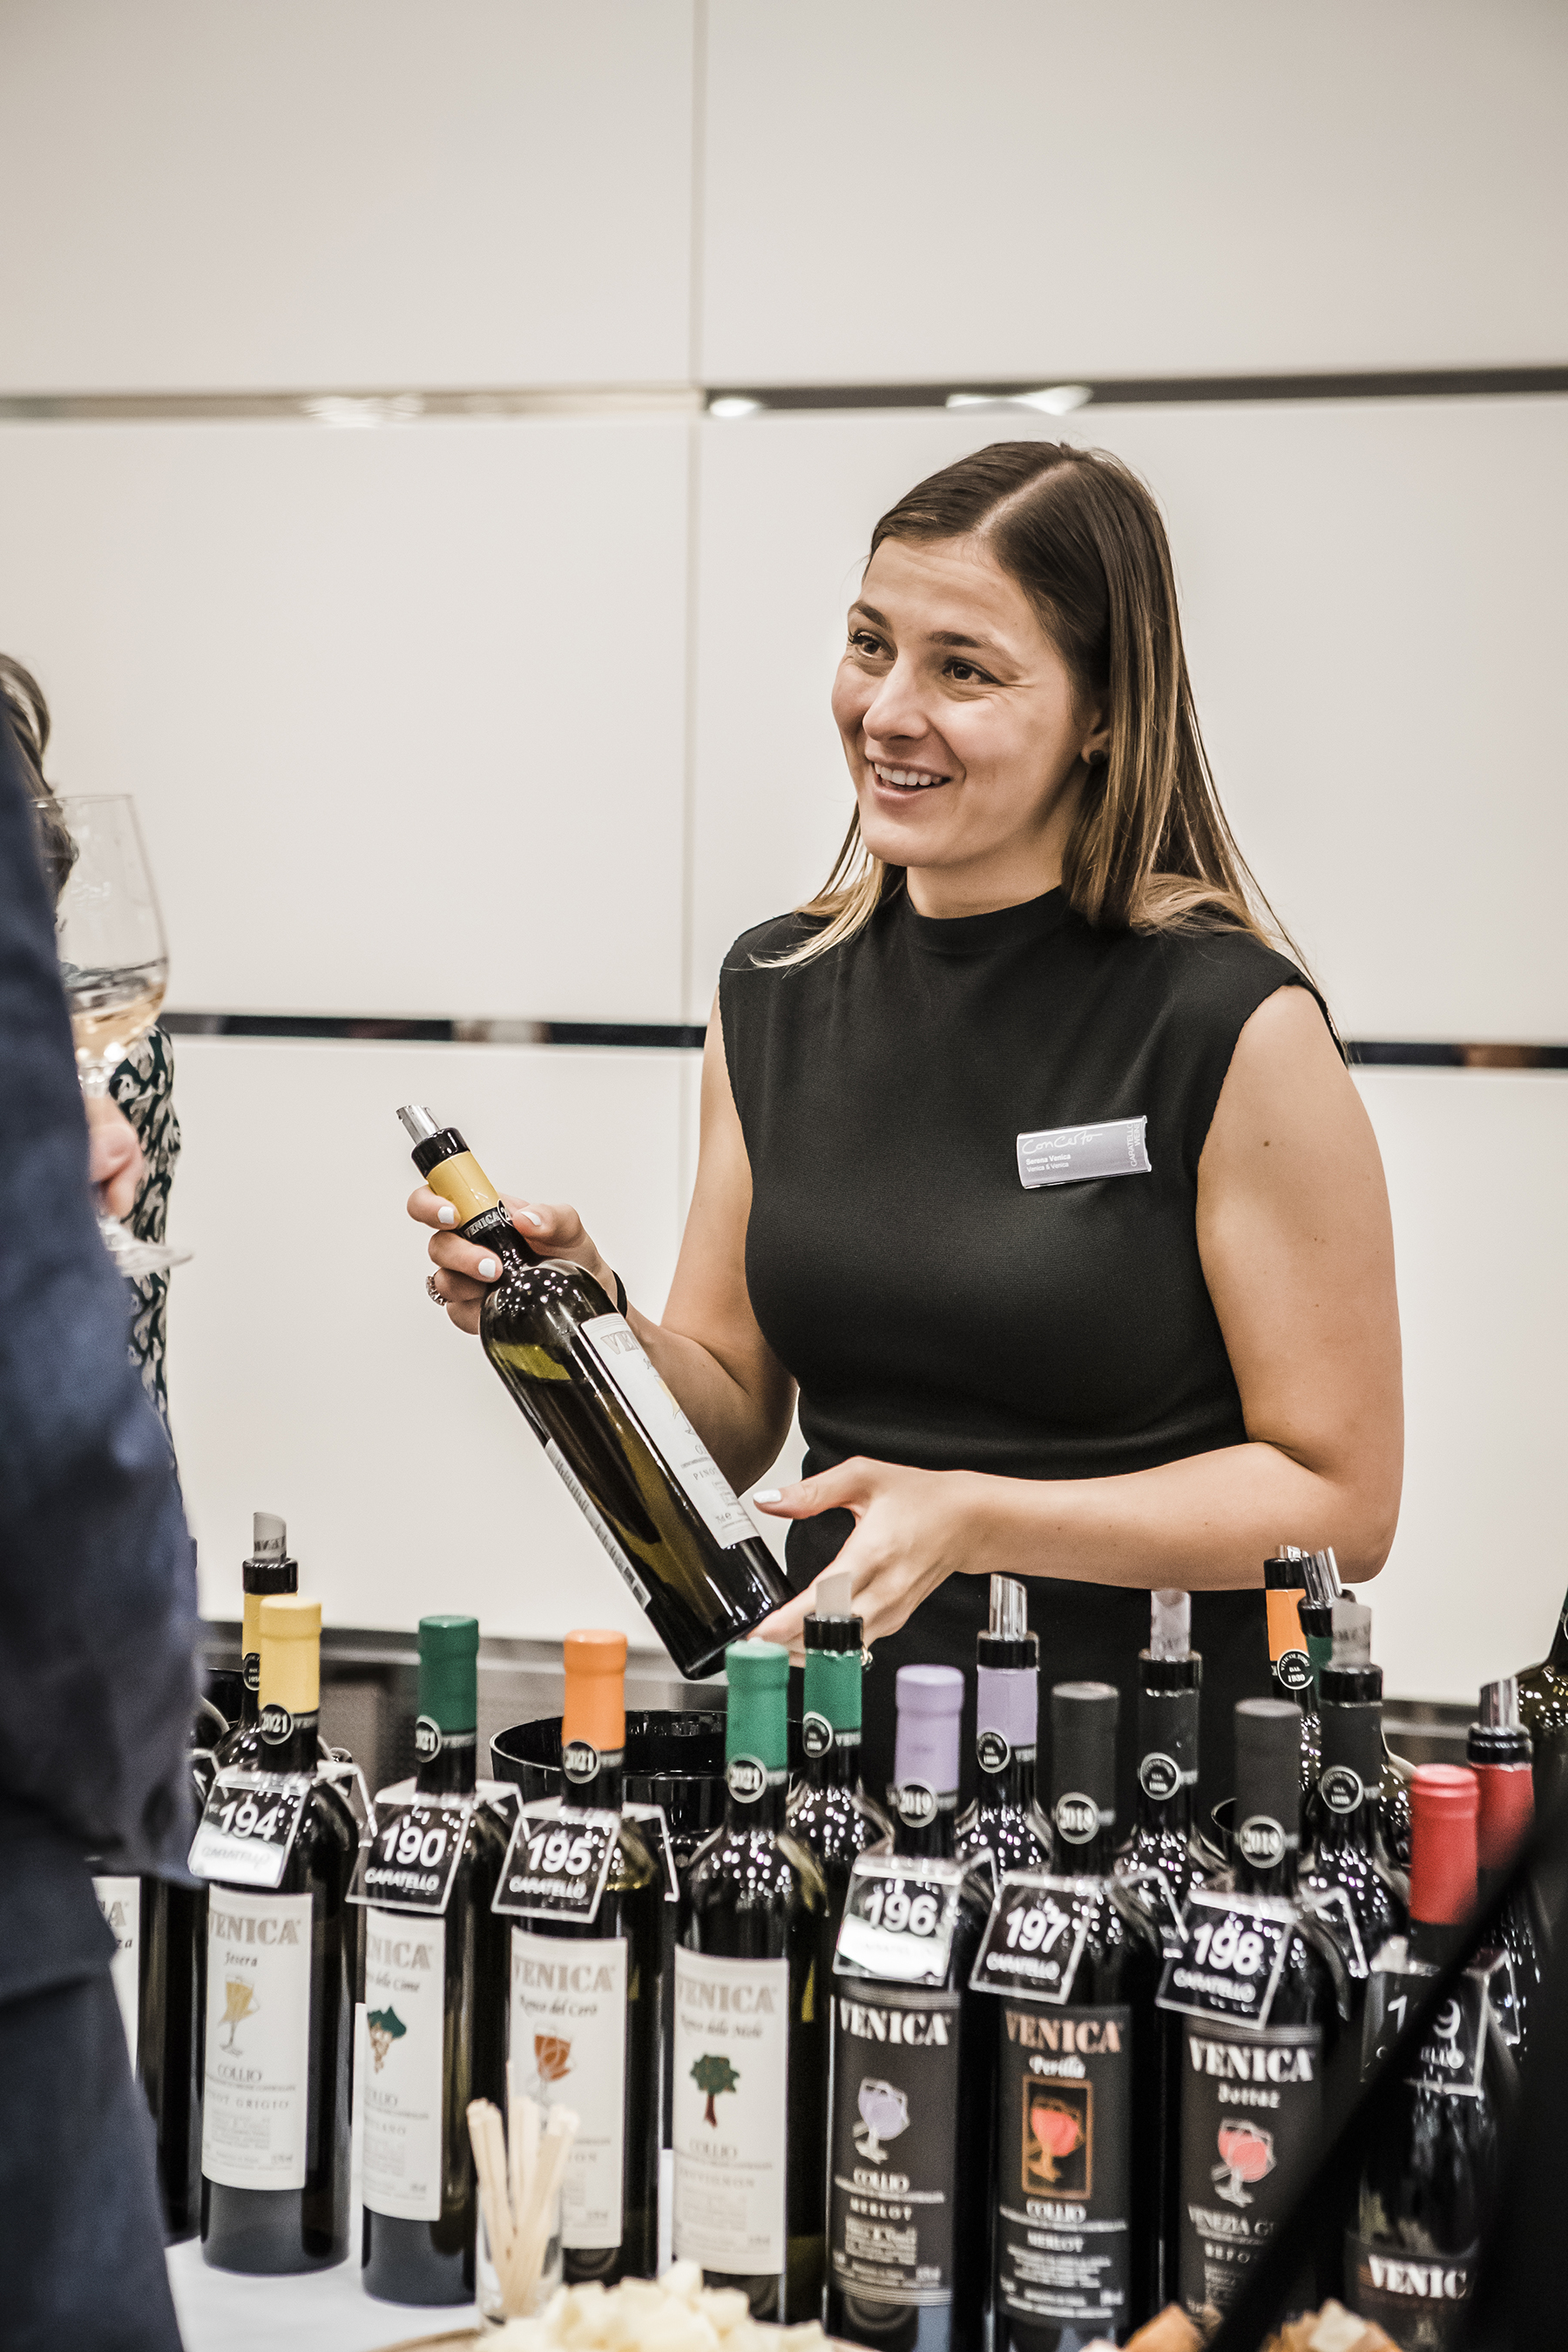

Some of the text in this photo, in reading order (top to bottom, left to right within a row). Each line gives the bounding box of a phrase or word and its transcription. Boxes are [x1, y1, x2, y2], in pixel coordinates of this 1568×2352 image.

[1025, 1153, 1071, 1166] Serena Venica
[463, 1211, 502, 1238] VENICA
[261, 1712, 288, 1734] 2021
[220, 1801, 278, 1842] 194
[382, 1825, 447, 1868] 190
[528, 1834, 594, 1876] 195
[364, 1868, 440, 1892] CARATELLO
[864, 1890, 938, 1936] 196
[1006, 1906, 1071, 1954] 197
[1193, 1922, 1265, 1976] 198
[840, 1997, 950, 2046] VENICA
[1005, 2009, 1122, 2054] VENICA
[1188, 2037, 1314, 2083] VENICA
[1204, 2241, 1251, 2265] REFO
[1368, 2254, 1467, 2300] VENIC
